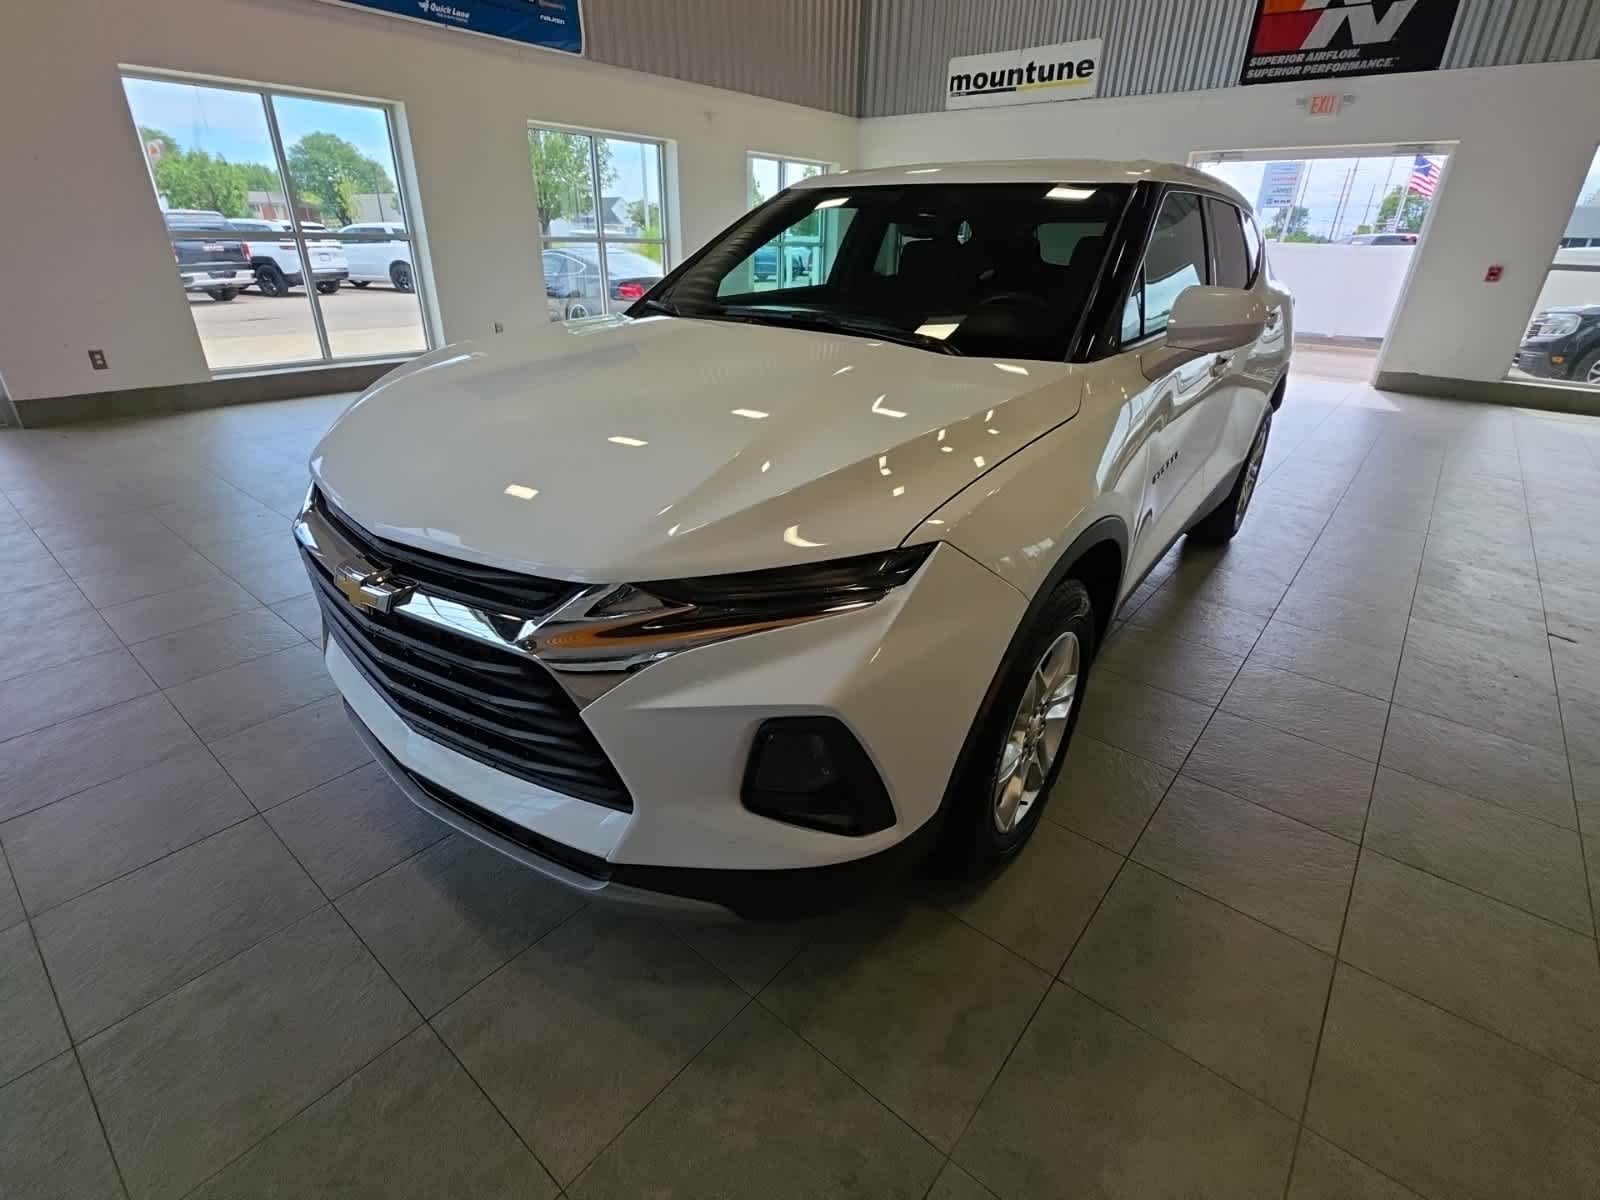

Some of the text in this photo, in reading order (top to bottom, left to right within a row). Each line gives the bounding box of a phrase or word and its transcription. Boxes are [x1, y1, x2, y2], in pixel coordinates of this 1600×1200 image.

[430, 2, 452, 14] Quick
[452, 7, 470, 18] Lane
[1249, 53, 1305, 67] SUPERIOR
[949, 58, 1096, 92] mountune
[1246, 65, 1302, 79] SUPERIOR
[1310, 95, 1338, 114] EXIT
